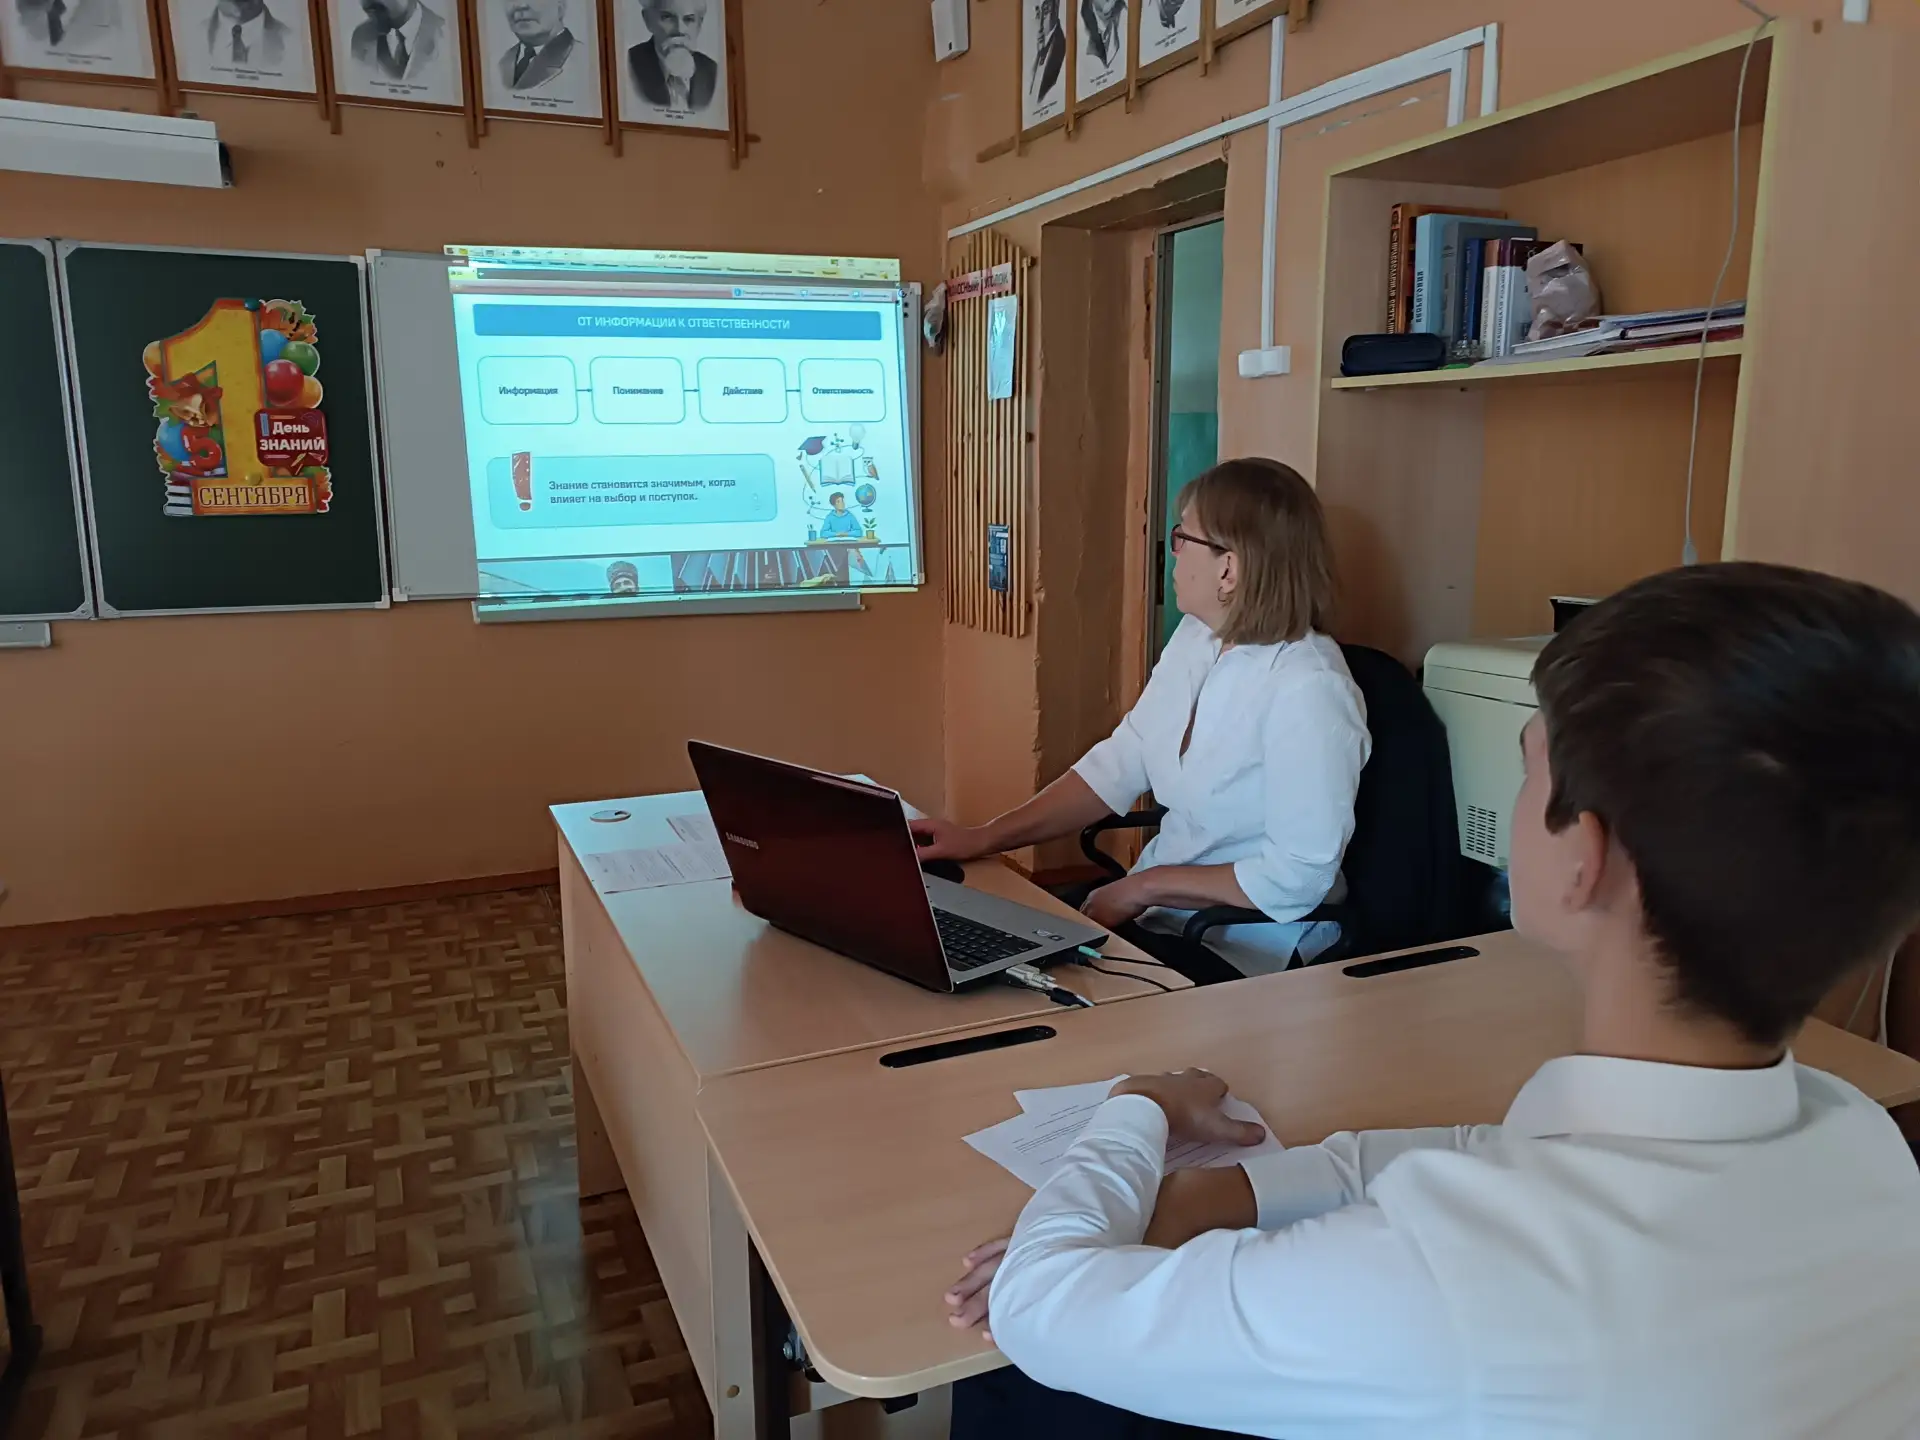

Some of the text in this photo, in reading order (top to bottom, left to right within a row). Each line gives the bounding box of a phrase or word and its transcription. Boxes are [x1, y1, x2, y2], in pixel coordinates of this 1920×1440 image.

[577, 316, 791, 330] ОТ ИНФОРМАЦИИ К ОТВЕТСТВЕННОСТИ
[498, 386, 559, 397] Информация
[612, 386, 664, 395] Понимание
[812, 386, 874, 395] Ответственность
[272, 421, 311, 437] День
[259, 436, 326, 451] ЗНАНИЙ
[549, 478, 737, 490] Знание становится значимым, когда
[198, 485, 309, 506] СЕНТЯБРЯ
[550, 493, 698, 504] влияет на выбор и поступок.
